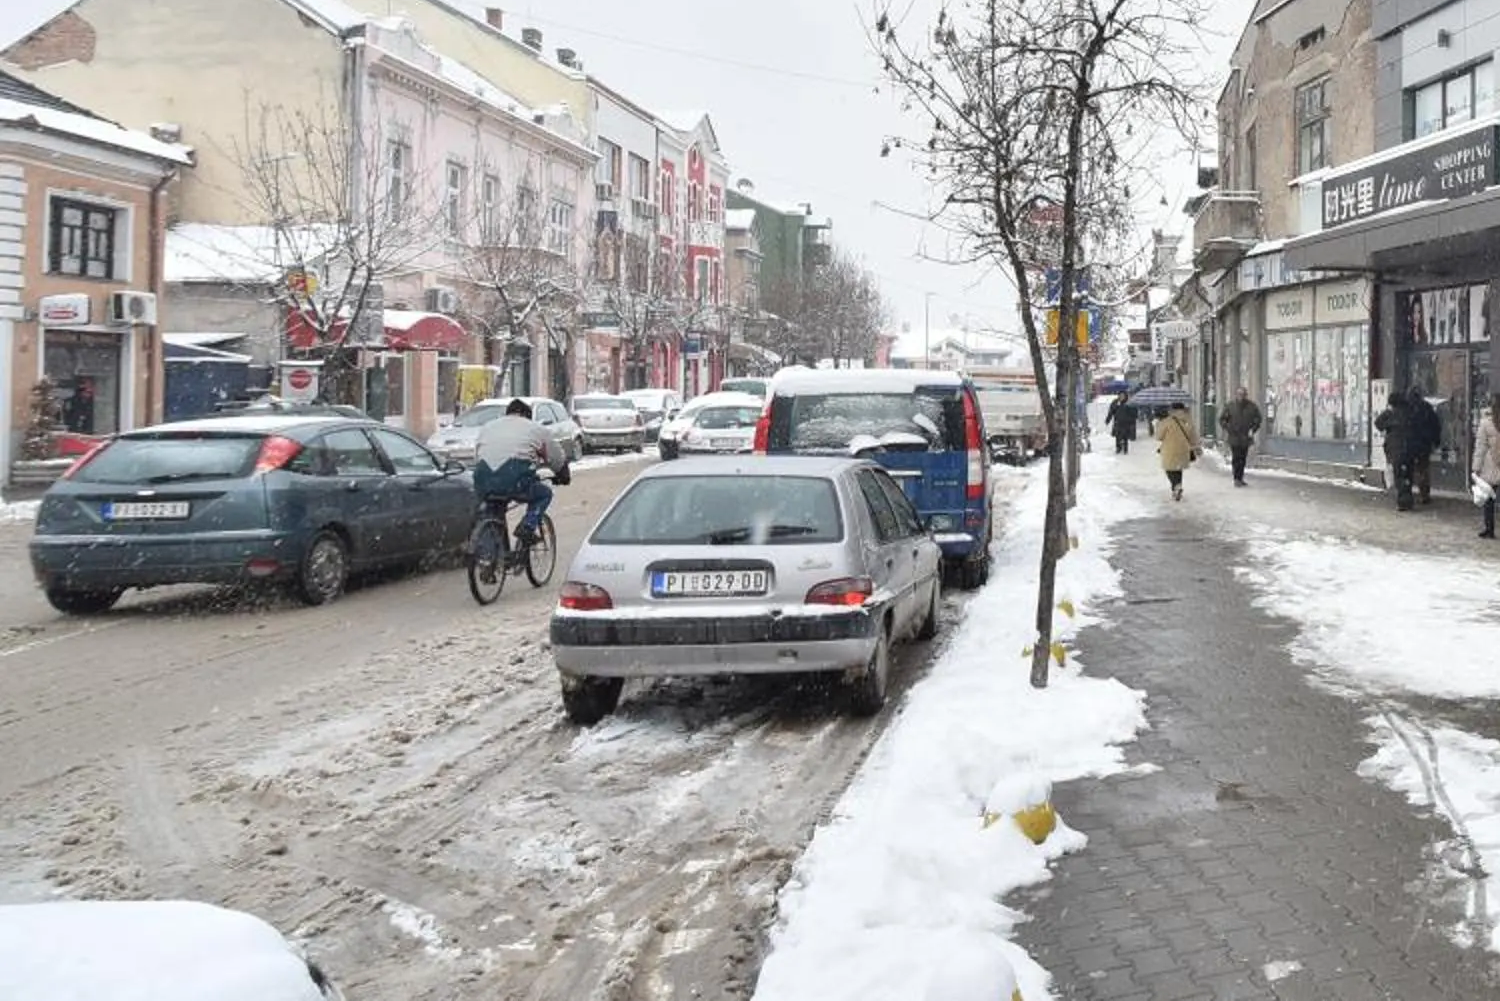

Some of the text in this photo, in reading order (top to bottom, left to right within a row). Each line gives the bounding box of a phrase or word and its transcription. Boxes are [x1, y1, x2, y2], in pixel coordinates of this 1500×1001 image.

[1434, 142, 1491, 172] SHOPPING
[1441, 164, 1485, 190] CENTER
[667, 572, 684, 591] PI
